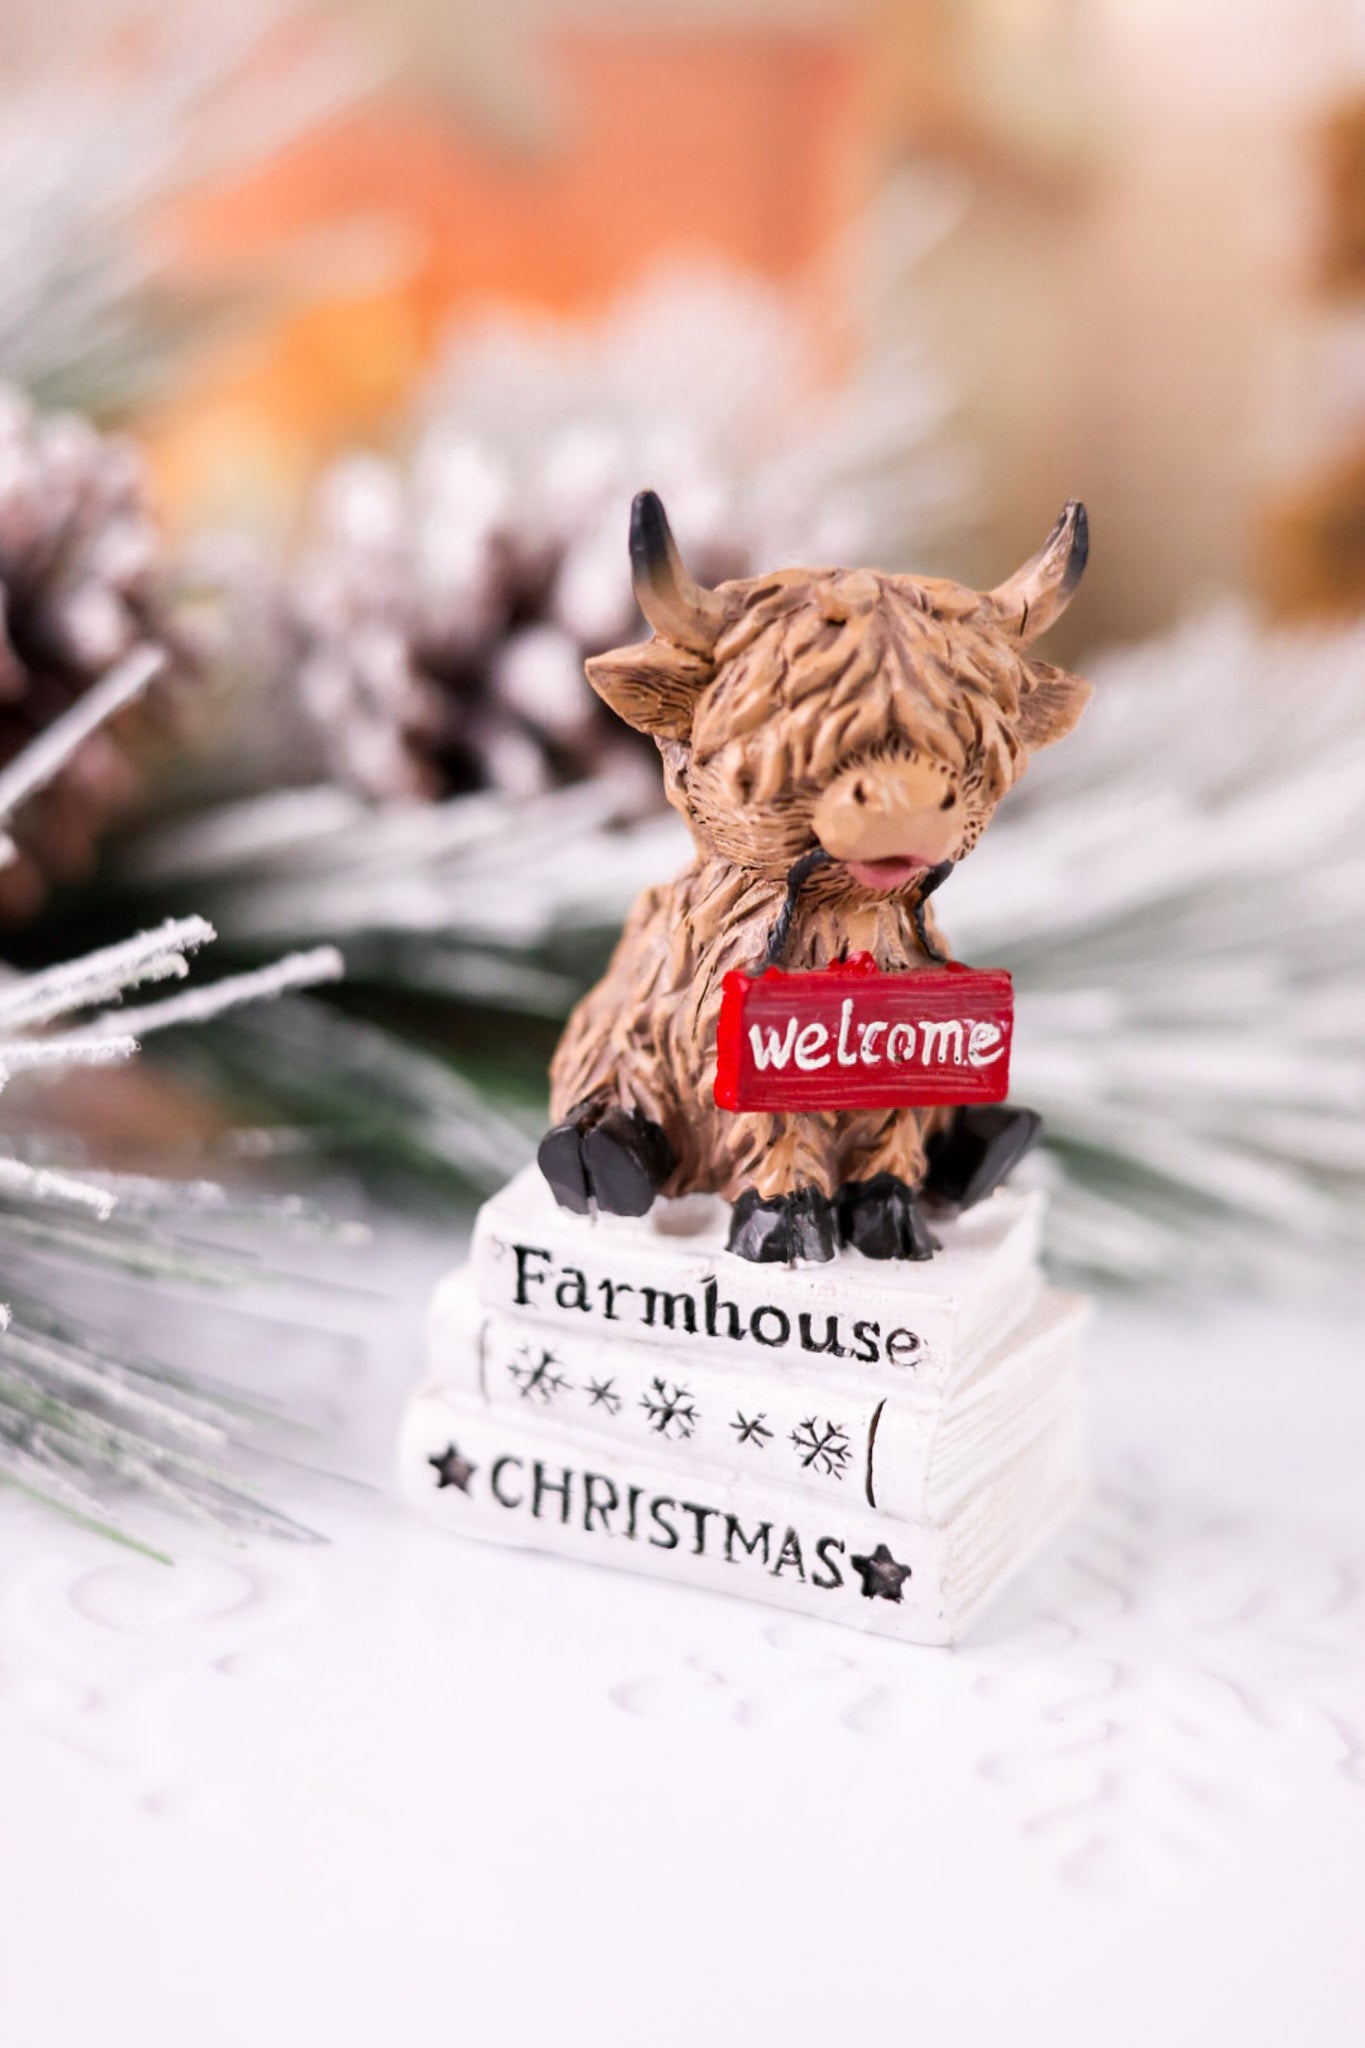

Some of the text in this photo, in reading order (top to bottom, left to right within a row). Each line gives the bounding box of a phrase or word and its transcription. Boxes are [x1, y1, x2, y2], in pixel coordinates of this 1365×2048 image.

[749, 998, 1004, 1070] welcome
[512, 1244, 921, 1367] Farmhouse
[490, 1455, 846, 1589] CHRISTMAS
